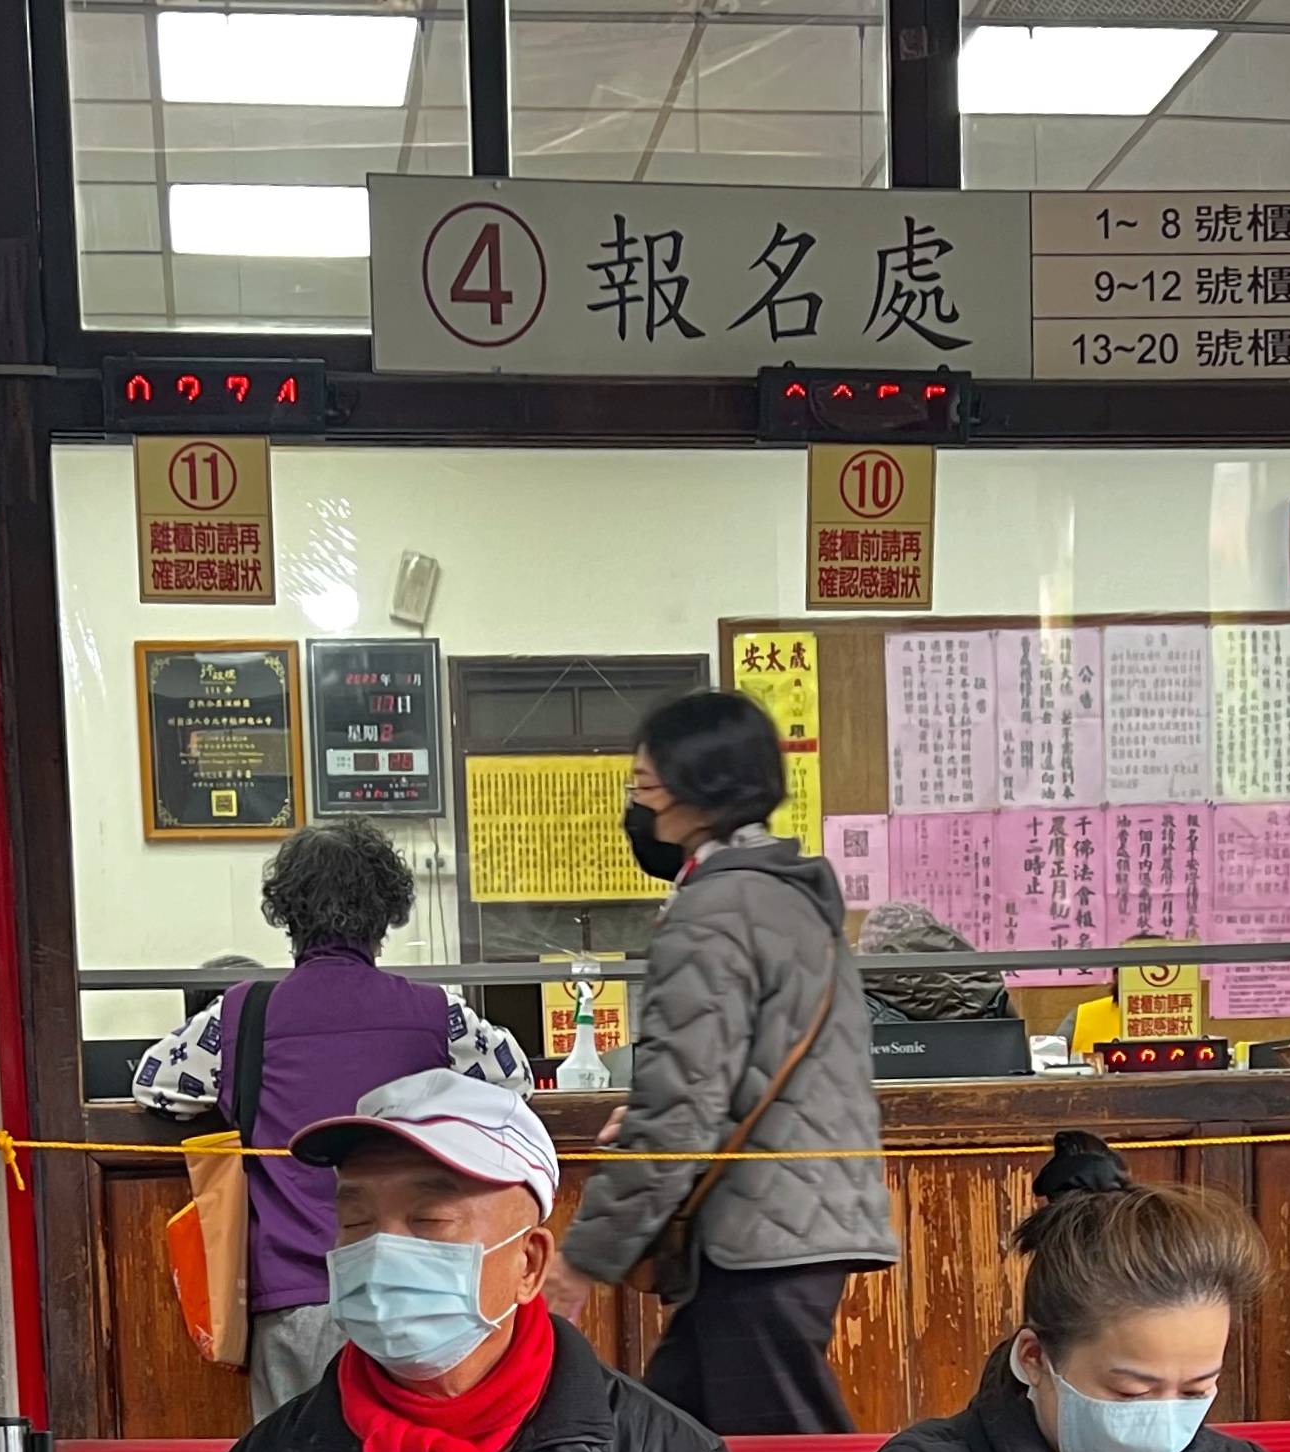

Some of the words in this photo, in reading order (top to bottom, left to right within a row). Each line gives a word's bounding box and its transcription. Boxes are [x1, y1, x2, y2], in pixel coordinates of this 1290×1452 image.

[585, 213, 974, 351] 報名處
[1093, 270, 1183, 303] 9~12
[1072, 332, 1180, 367] 13~20
[149, 521, 261, 556] 離櫃前請再
[817, 527, 922, 563] 離櫃前請再
[151, 557, 263, 594] 確認感謝狀
[817, 565, 922, 600] 確認感謝狀
[741, 641, 812, 673] 安太歲
[1126, 994, 1194, 1015] 離櫃前請再
[871, 1041, 927, 1055] iewSonic
